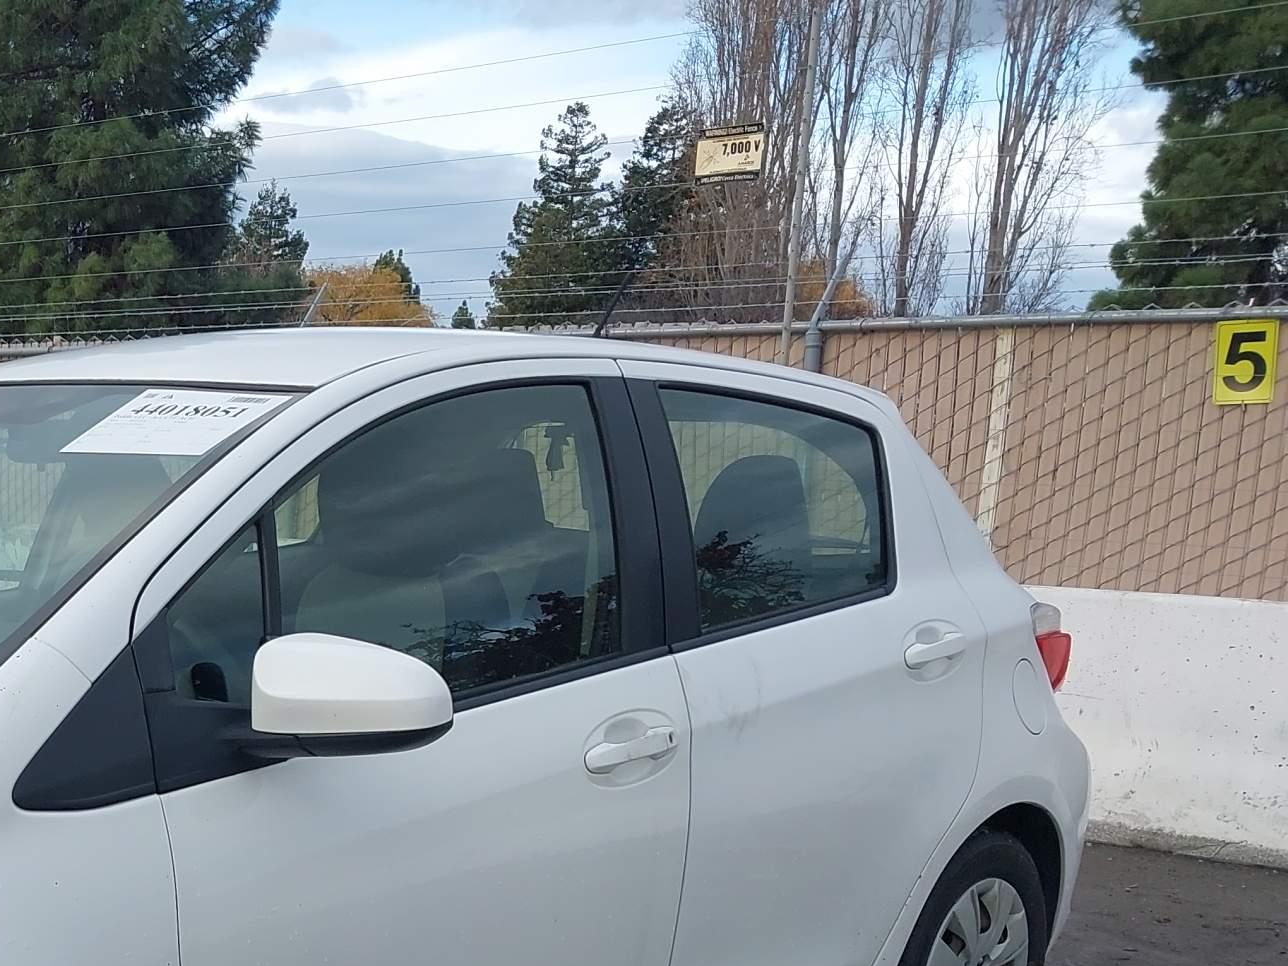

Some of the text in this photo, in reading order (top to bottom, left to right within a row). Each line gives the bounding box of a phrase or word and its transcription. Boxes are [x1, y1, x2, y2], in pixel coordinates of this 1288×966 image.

[722, 139, 761, 157] 7,000 V
[1222, 330, 1267, 393] 5
[130, 403, 250, 418] 44018051
